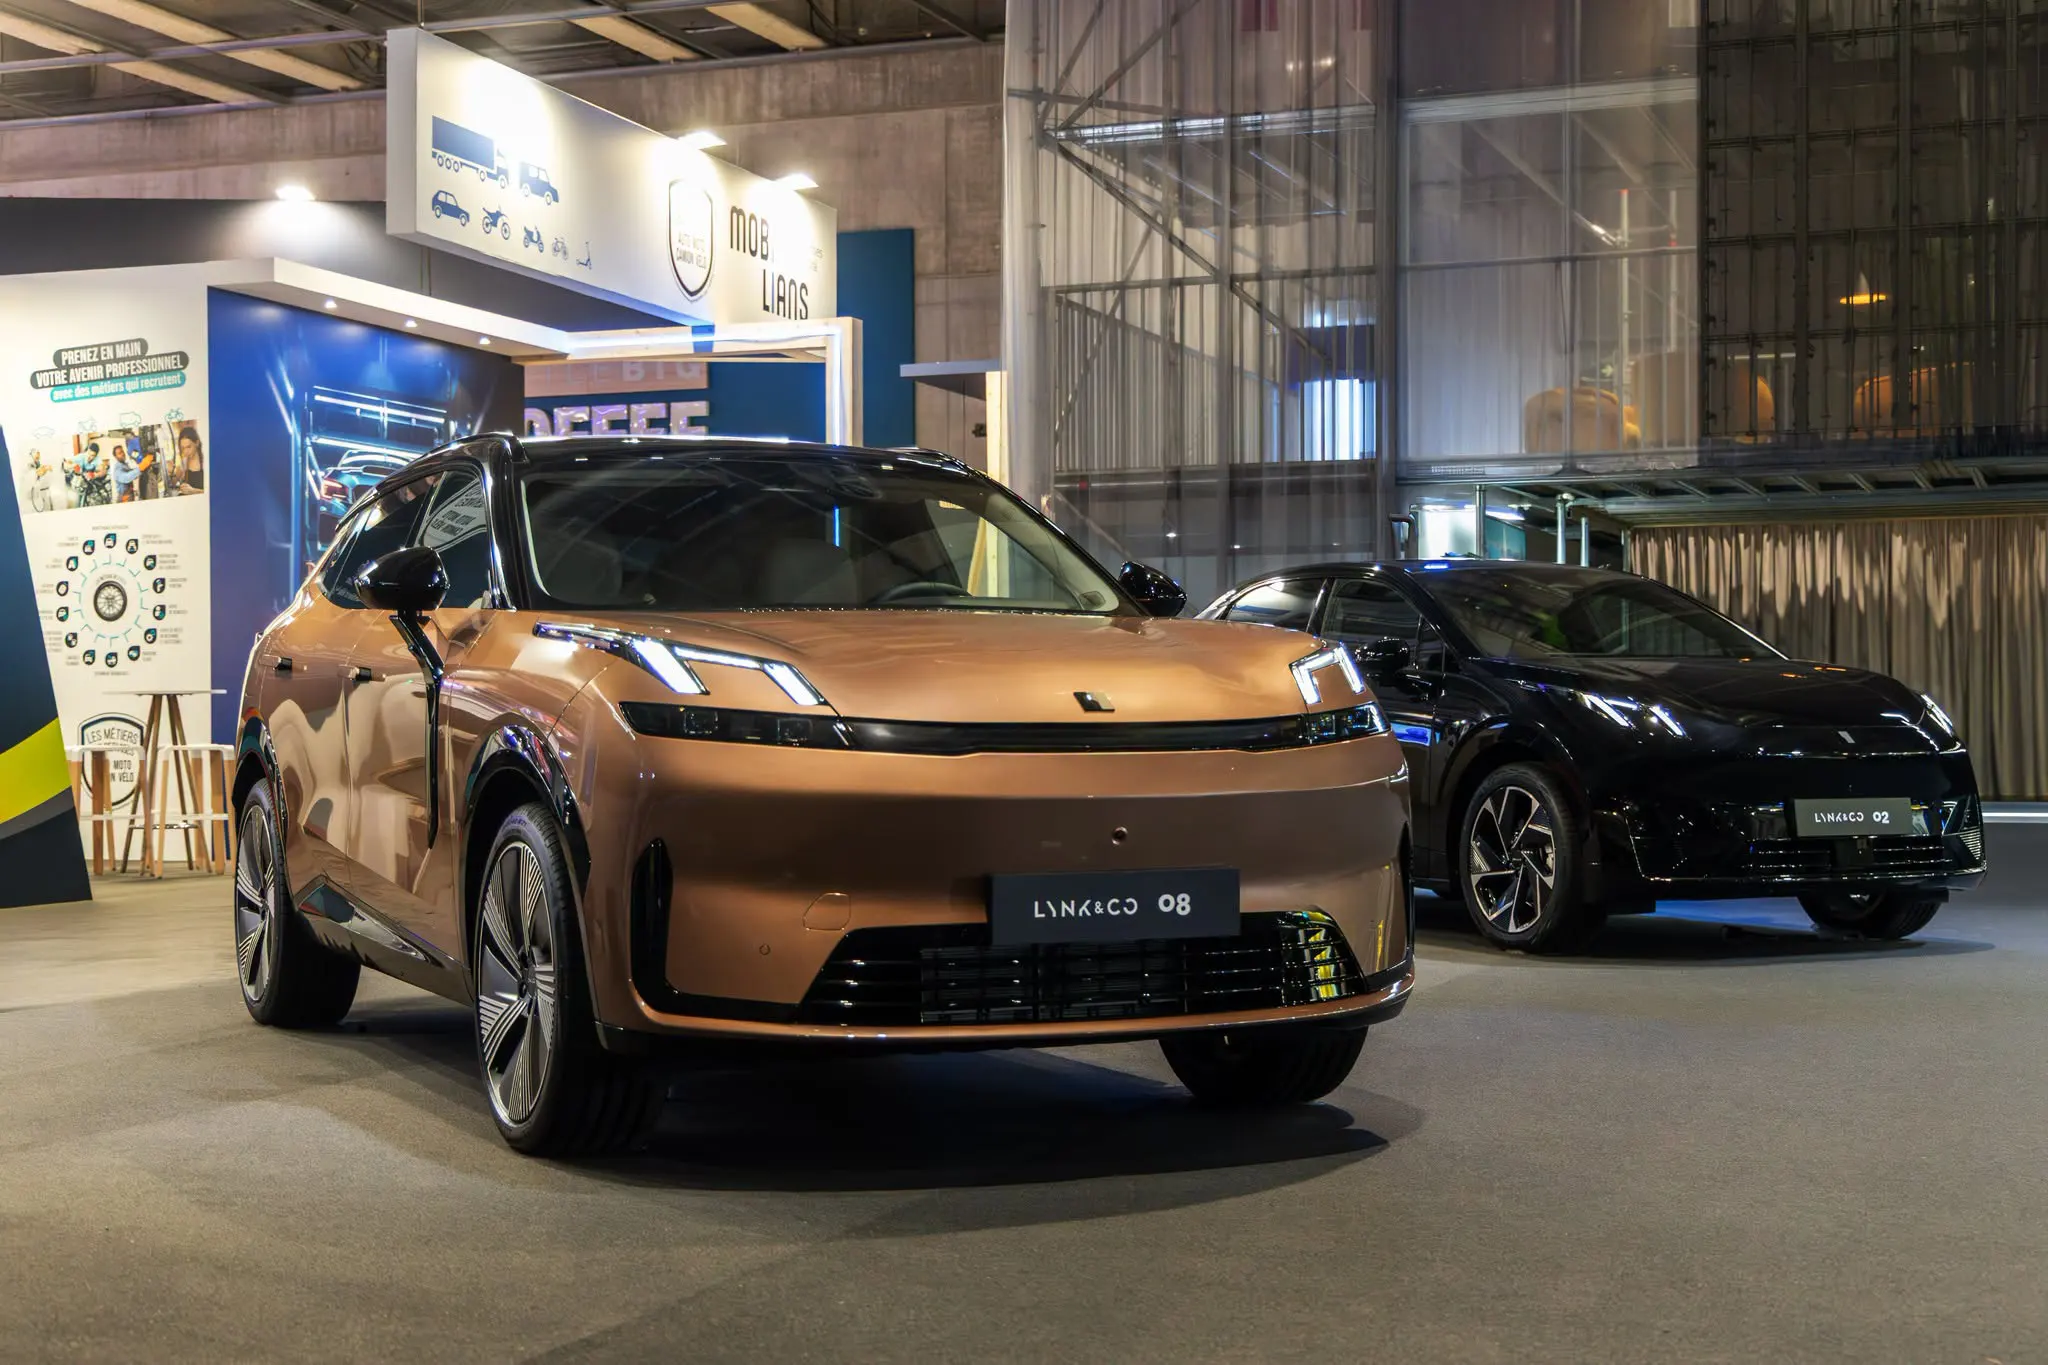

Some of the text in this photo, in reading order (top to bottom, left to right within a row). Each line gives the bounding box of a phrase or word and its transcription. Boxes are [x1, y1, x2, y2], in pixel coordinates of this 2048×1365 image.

[763, 269, 808, 320] LIANS
[61, 340, 141, 366] PRENEZ EN MAIN
[36, 354, 184, 387] VOTRE AVENIR PROFESSIONNEL
[53, 373, 181, 401] avec des métiers qui recrutent
[86, 727, 139, 745] LES MÉTIERS
[113, 759, 132, 770] MOTO
[118, 771, 134, 782] VÉLO
[1872, 811, 1890, 824] 02
[1034, 892, 1191, 918] LYNK&CO 08
